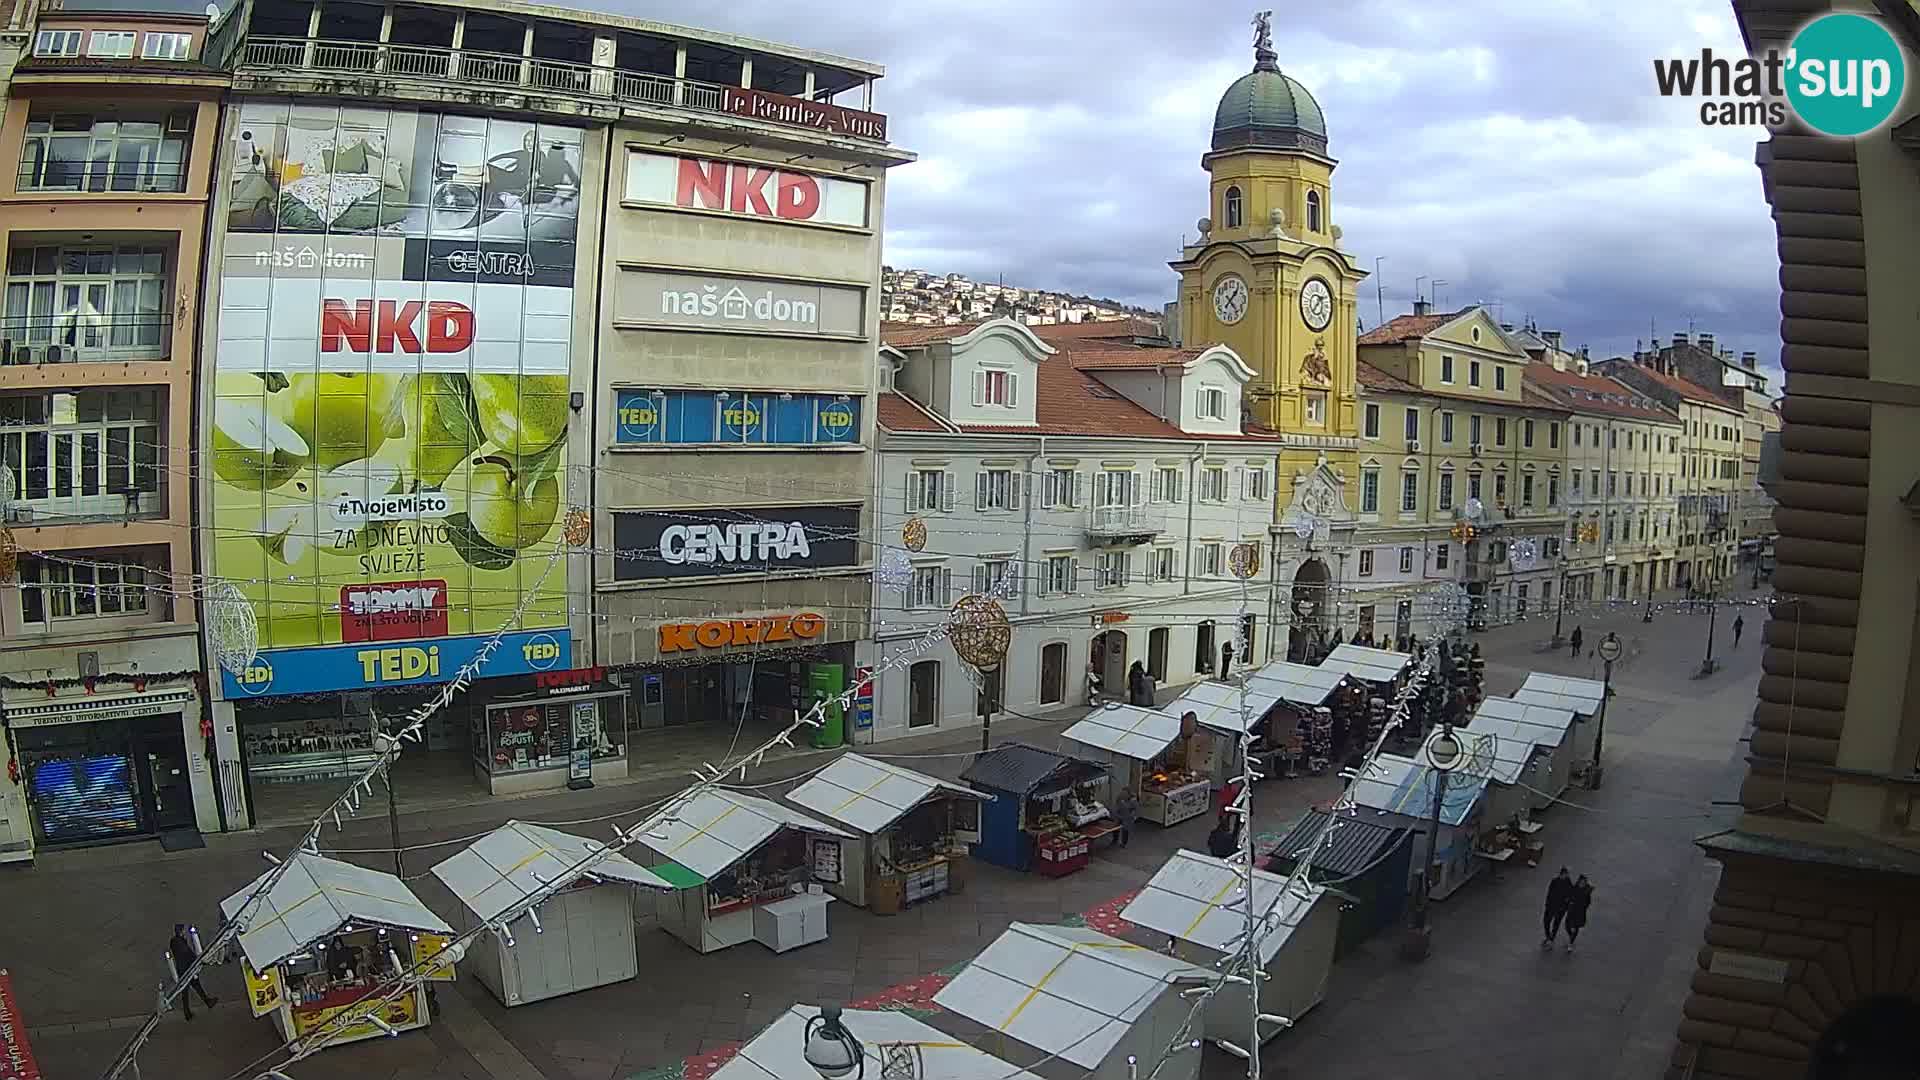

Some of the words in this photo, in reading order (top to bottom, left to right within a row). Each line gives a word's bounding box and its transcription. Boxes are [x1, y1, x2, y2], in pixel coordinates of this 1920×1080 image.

[723, 89, 745, 112] Le
[676, 158, 820, 220] NKD
[255, 245, 294, 268] naš
[323, 247, 366, 269] dom
[448, 250, 536, 276] CENTRA
[662, 284, 718, 316] naš
[754, 291, 816, 323] dom
[321, 298, 476, 354] NKD
[619, 408, 658, 425] TEDi
[723, 409, 760, 426] TEDi
[820, 411, 853, 427] TEDi
[338, 498, 446, 516] #TvojeMisto
[334, 528, 358, 549] ZA
[367, 524, 451, 548] DNEVNO
[660, 521, 810, 564] CENTRA
[359, 547, 427, 575] SVJEŽE
[659, 612, 826, 654] KORZO
[358, 646, 440, 683] TEDi
[523, 642, 561, 662] TEDi
